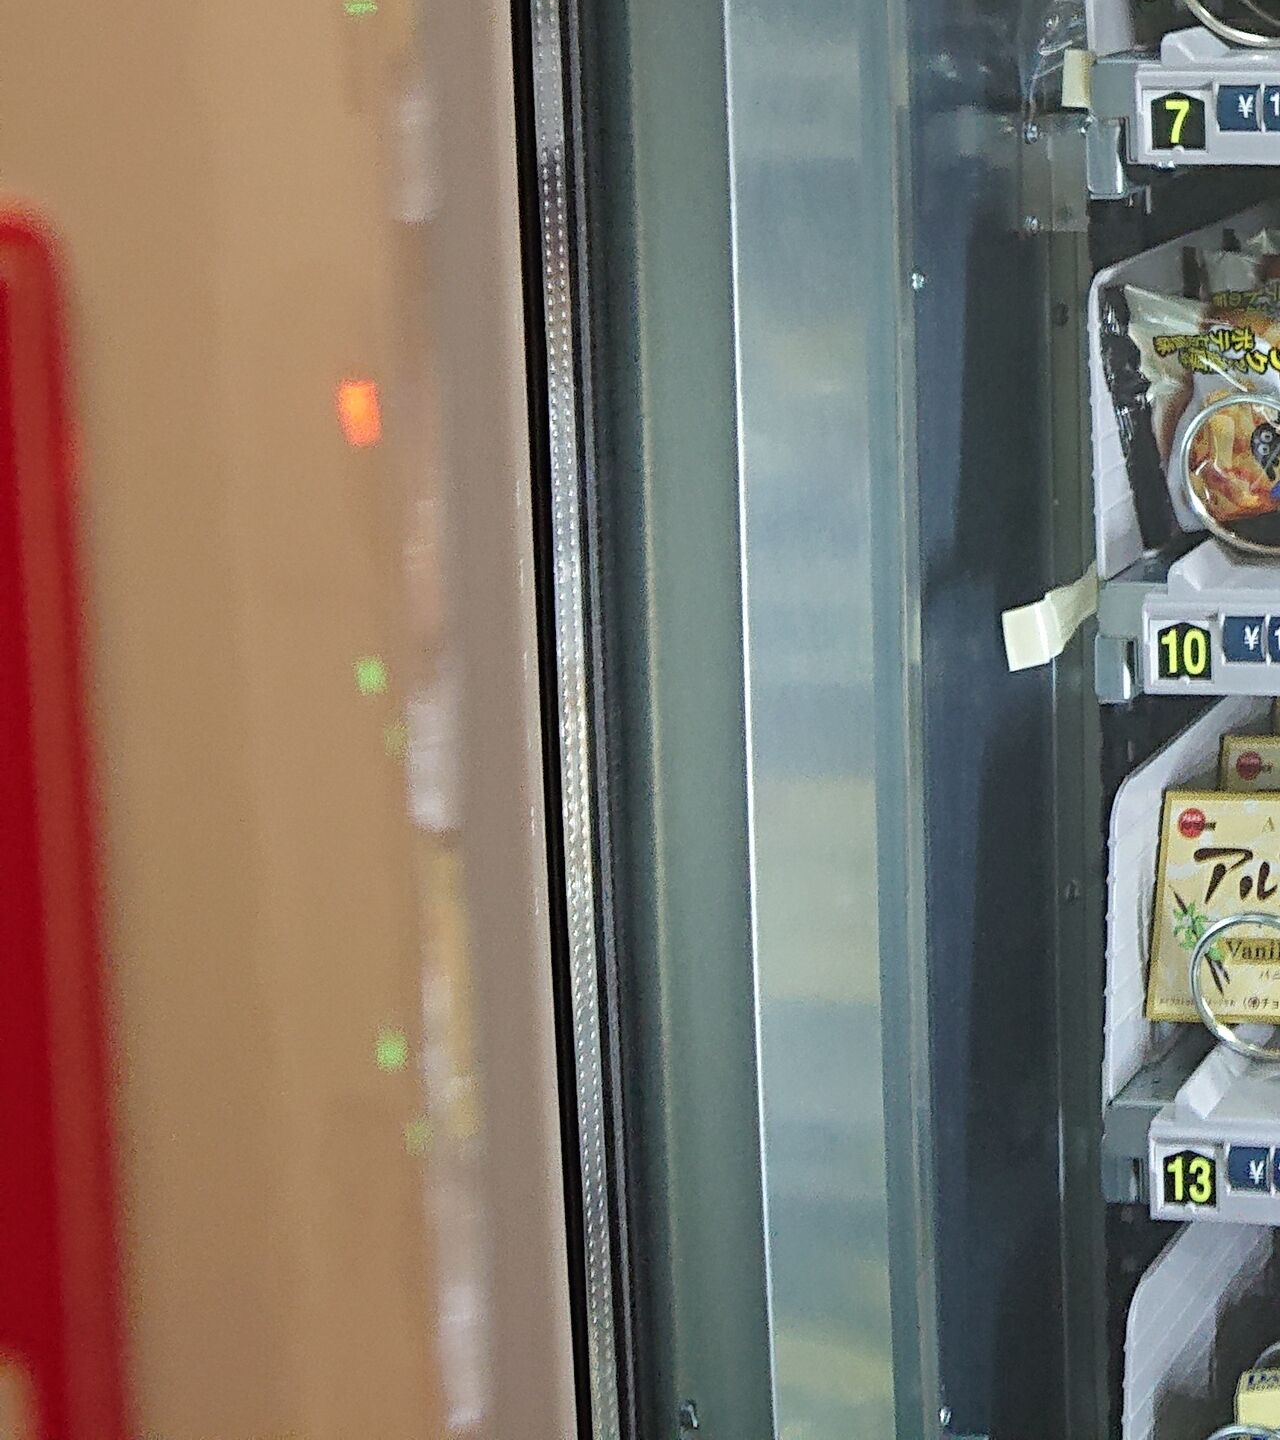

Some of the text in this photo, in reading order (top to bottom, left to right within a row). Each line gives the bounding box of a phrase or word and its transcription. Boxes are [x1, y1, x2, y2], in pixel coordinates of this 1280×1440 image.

[1164, 100, 1191, 145] 7
[1160, 627, 1209, 675] 10
[1167, 1156, 1211, 1204] 13
